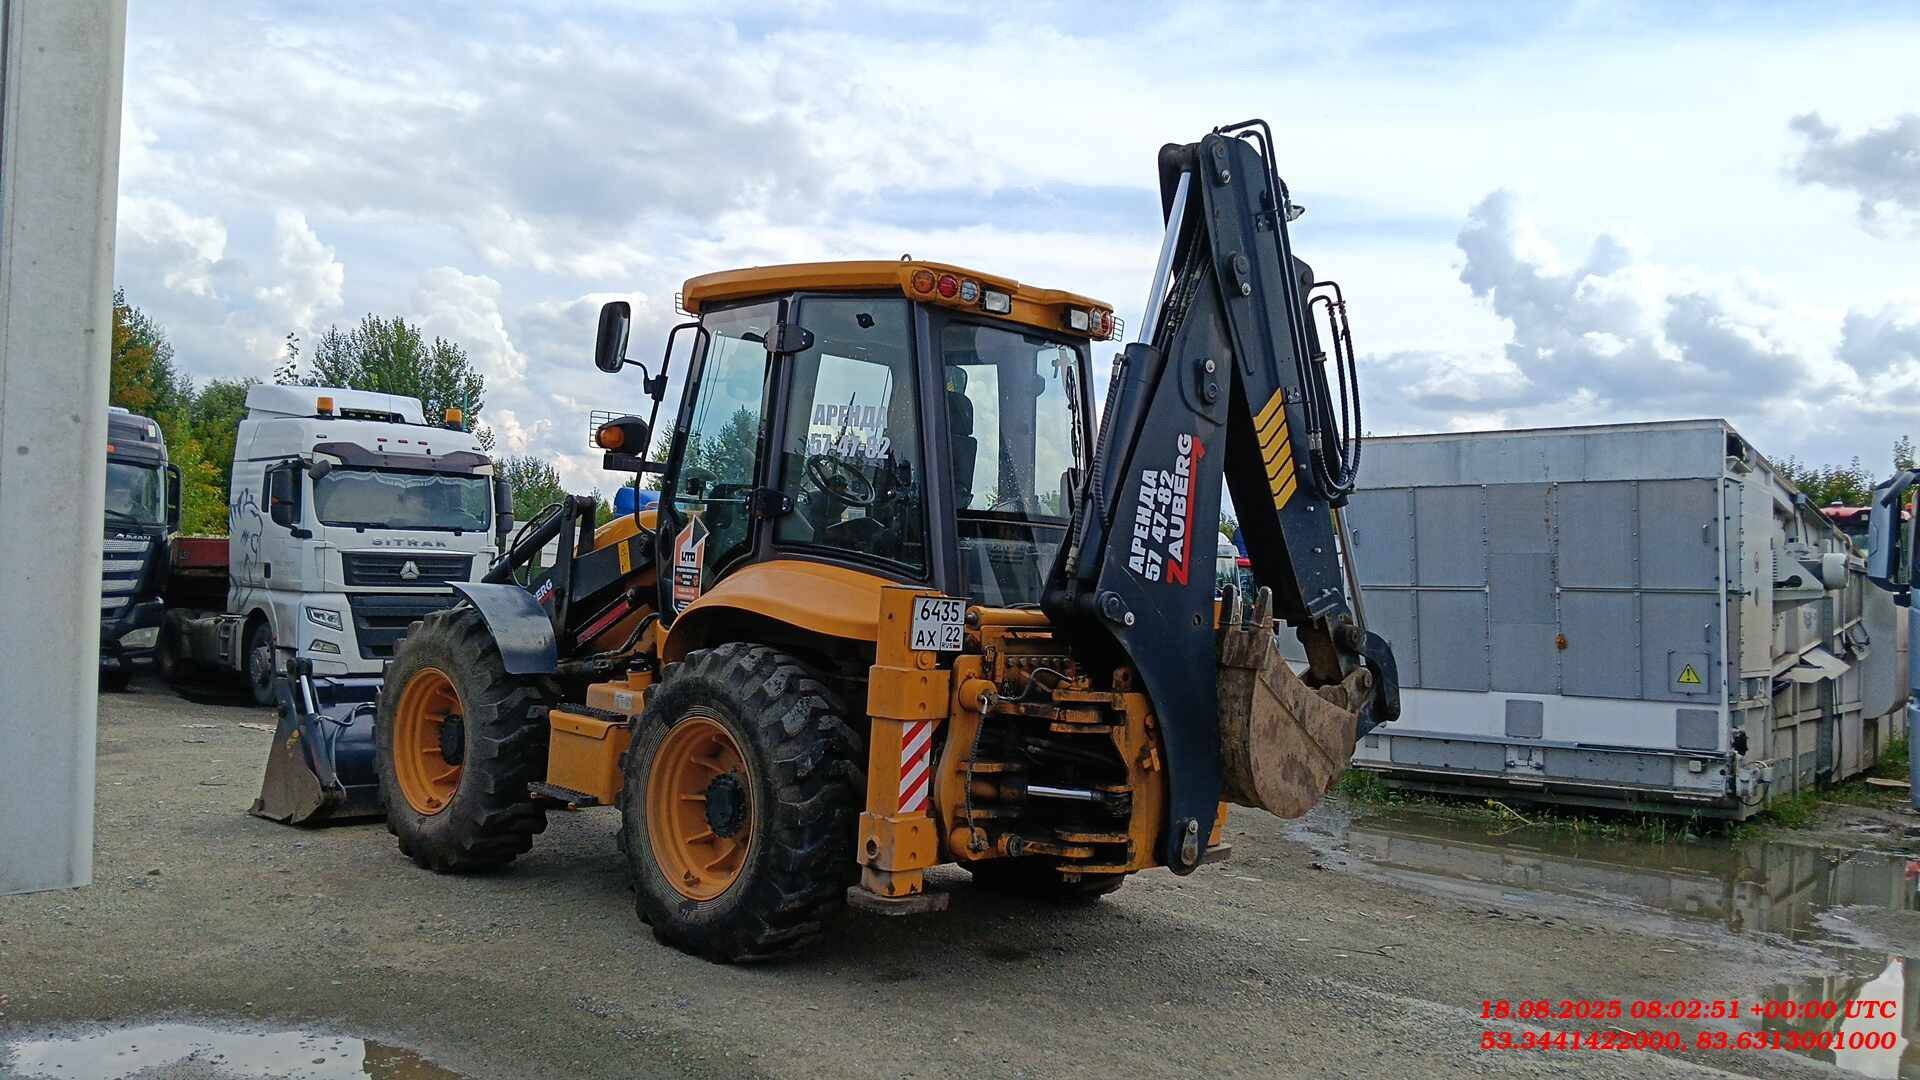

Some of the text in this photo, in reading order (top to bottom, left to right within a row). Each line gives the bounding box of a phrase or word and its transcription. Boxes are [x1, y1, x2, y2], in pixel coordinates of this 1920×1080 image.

[812, 404, 887, 428] АРЕНДА
[809, 433, 891, 459] 57-47-82
[1166, 432, 1206, 587] ZAUBERG
[1128, 469, 1159, 575] АРЕНДА
[1144, 469, 1175, 582] 57 47-82
[371, 538, 447, 548] SITRAK
[534, 578, 553, 601] ERG
[920, 599, 960, 622] 6435
[945, 626, 961, 643] 22
